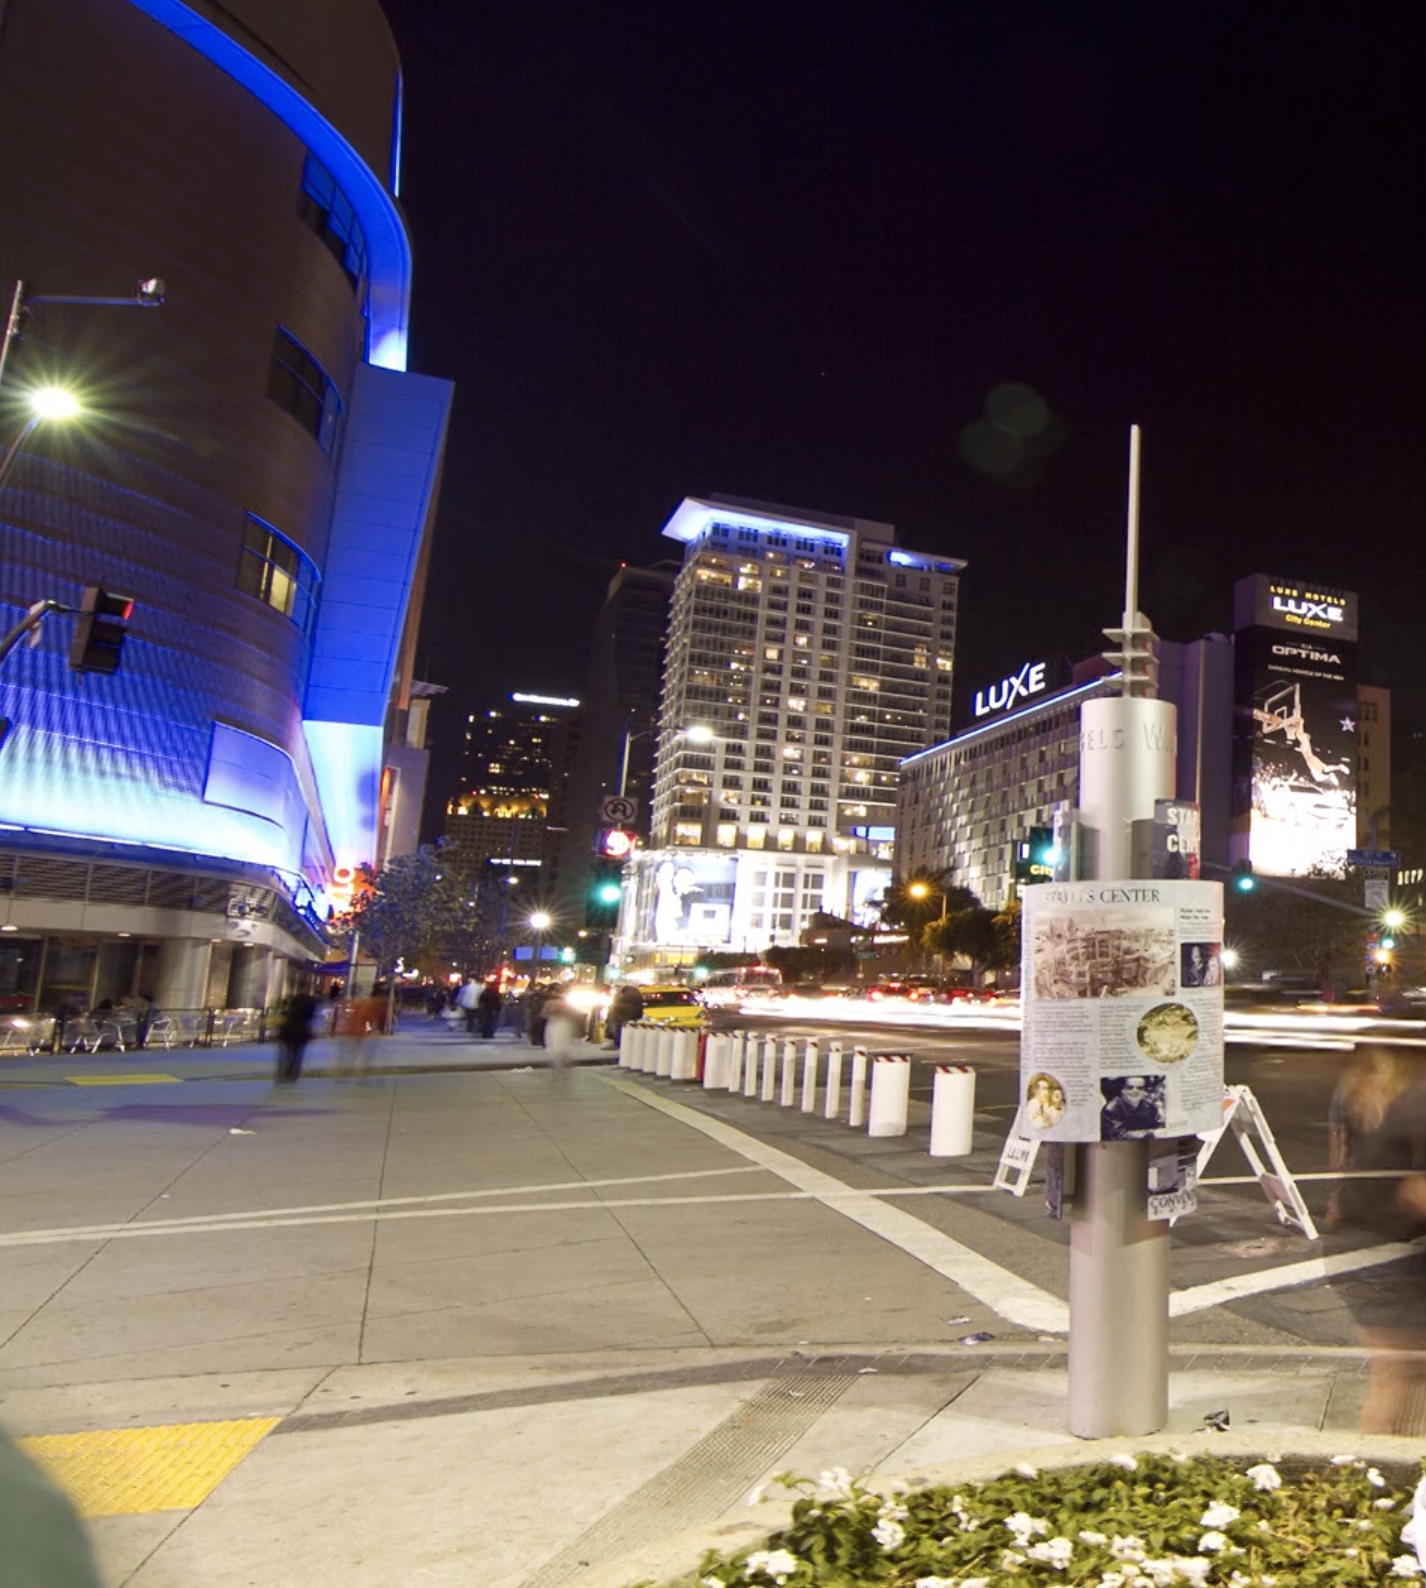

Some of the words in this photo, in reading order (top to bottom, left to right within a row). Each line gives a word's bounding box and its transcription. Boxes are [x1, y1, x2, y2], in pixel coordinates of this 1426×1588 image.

[1269, 585, 1298, 597] LUXE
[1304, 592, 1346, 606] HOTELS
[1272, 596, 1344, 622] LUXE
[1285, 614, 1302, 625] City
[1303, 617, 1331, 629] Center
[1272, 645, 1342, 664] OPTIMA
[975, 662, 1047, 717] LUXE
[1099, 888, 1161, 904] CENTER
